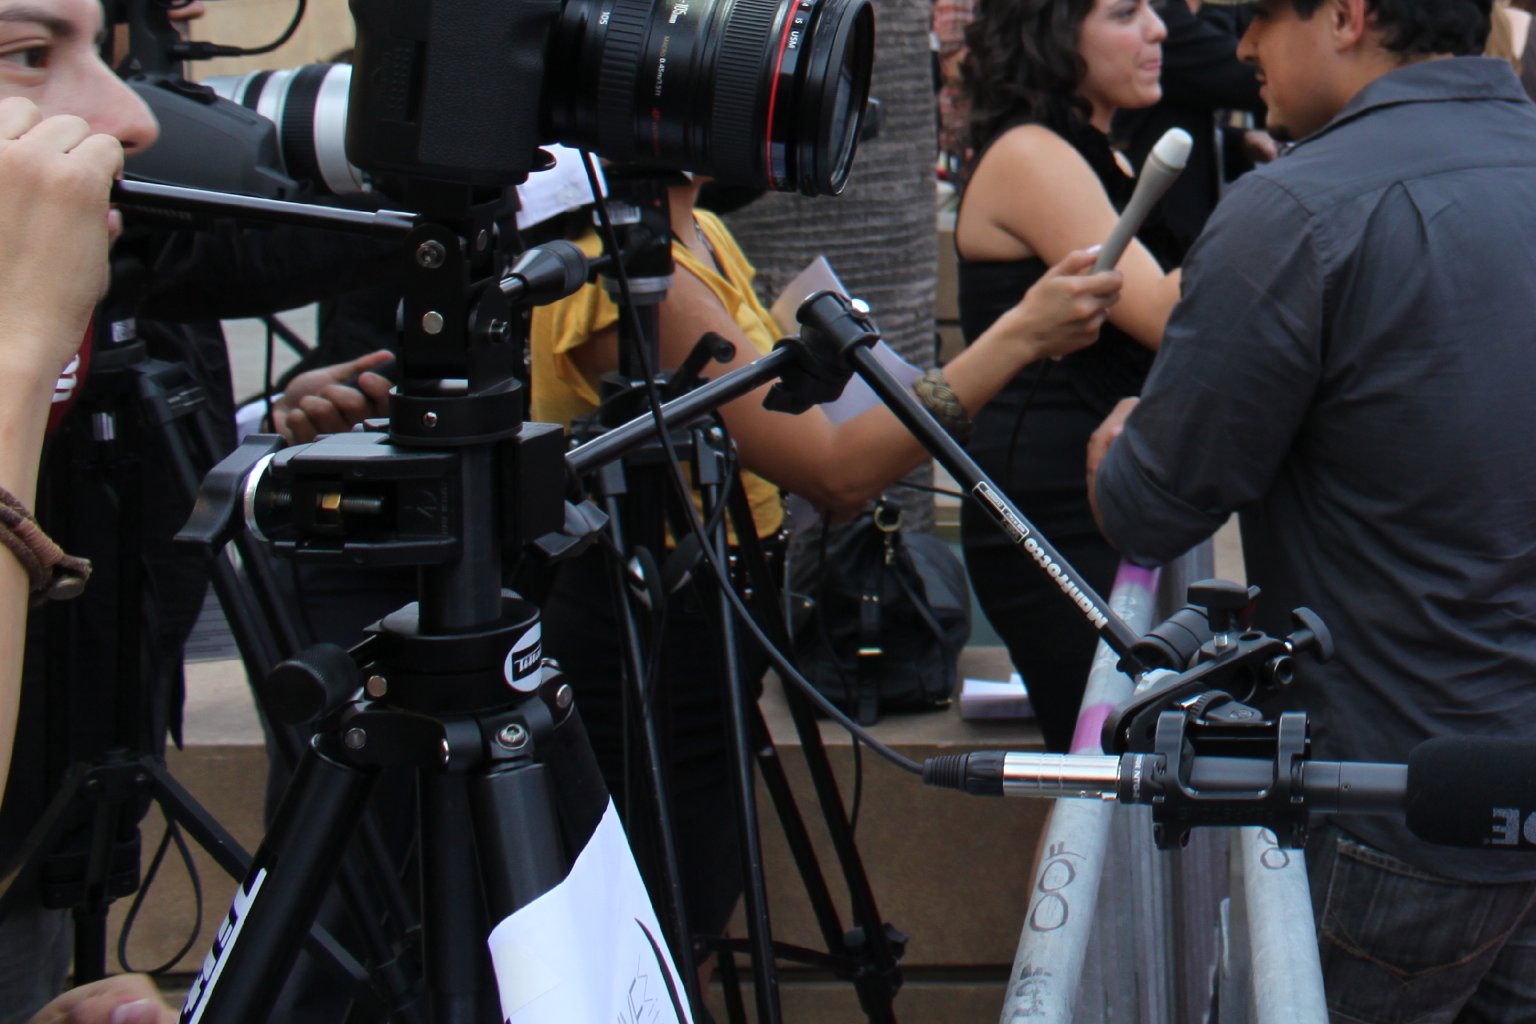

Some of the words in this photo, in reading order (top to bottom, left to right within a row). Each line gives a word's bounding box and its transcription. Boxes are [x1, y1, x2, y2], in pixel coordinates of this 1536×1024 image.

[599, 11, 610, 25] 105
[788, 31, 800, 49] USM
[1023, 537, 1109, 630] Manfrotto
